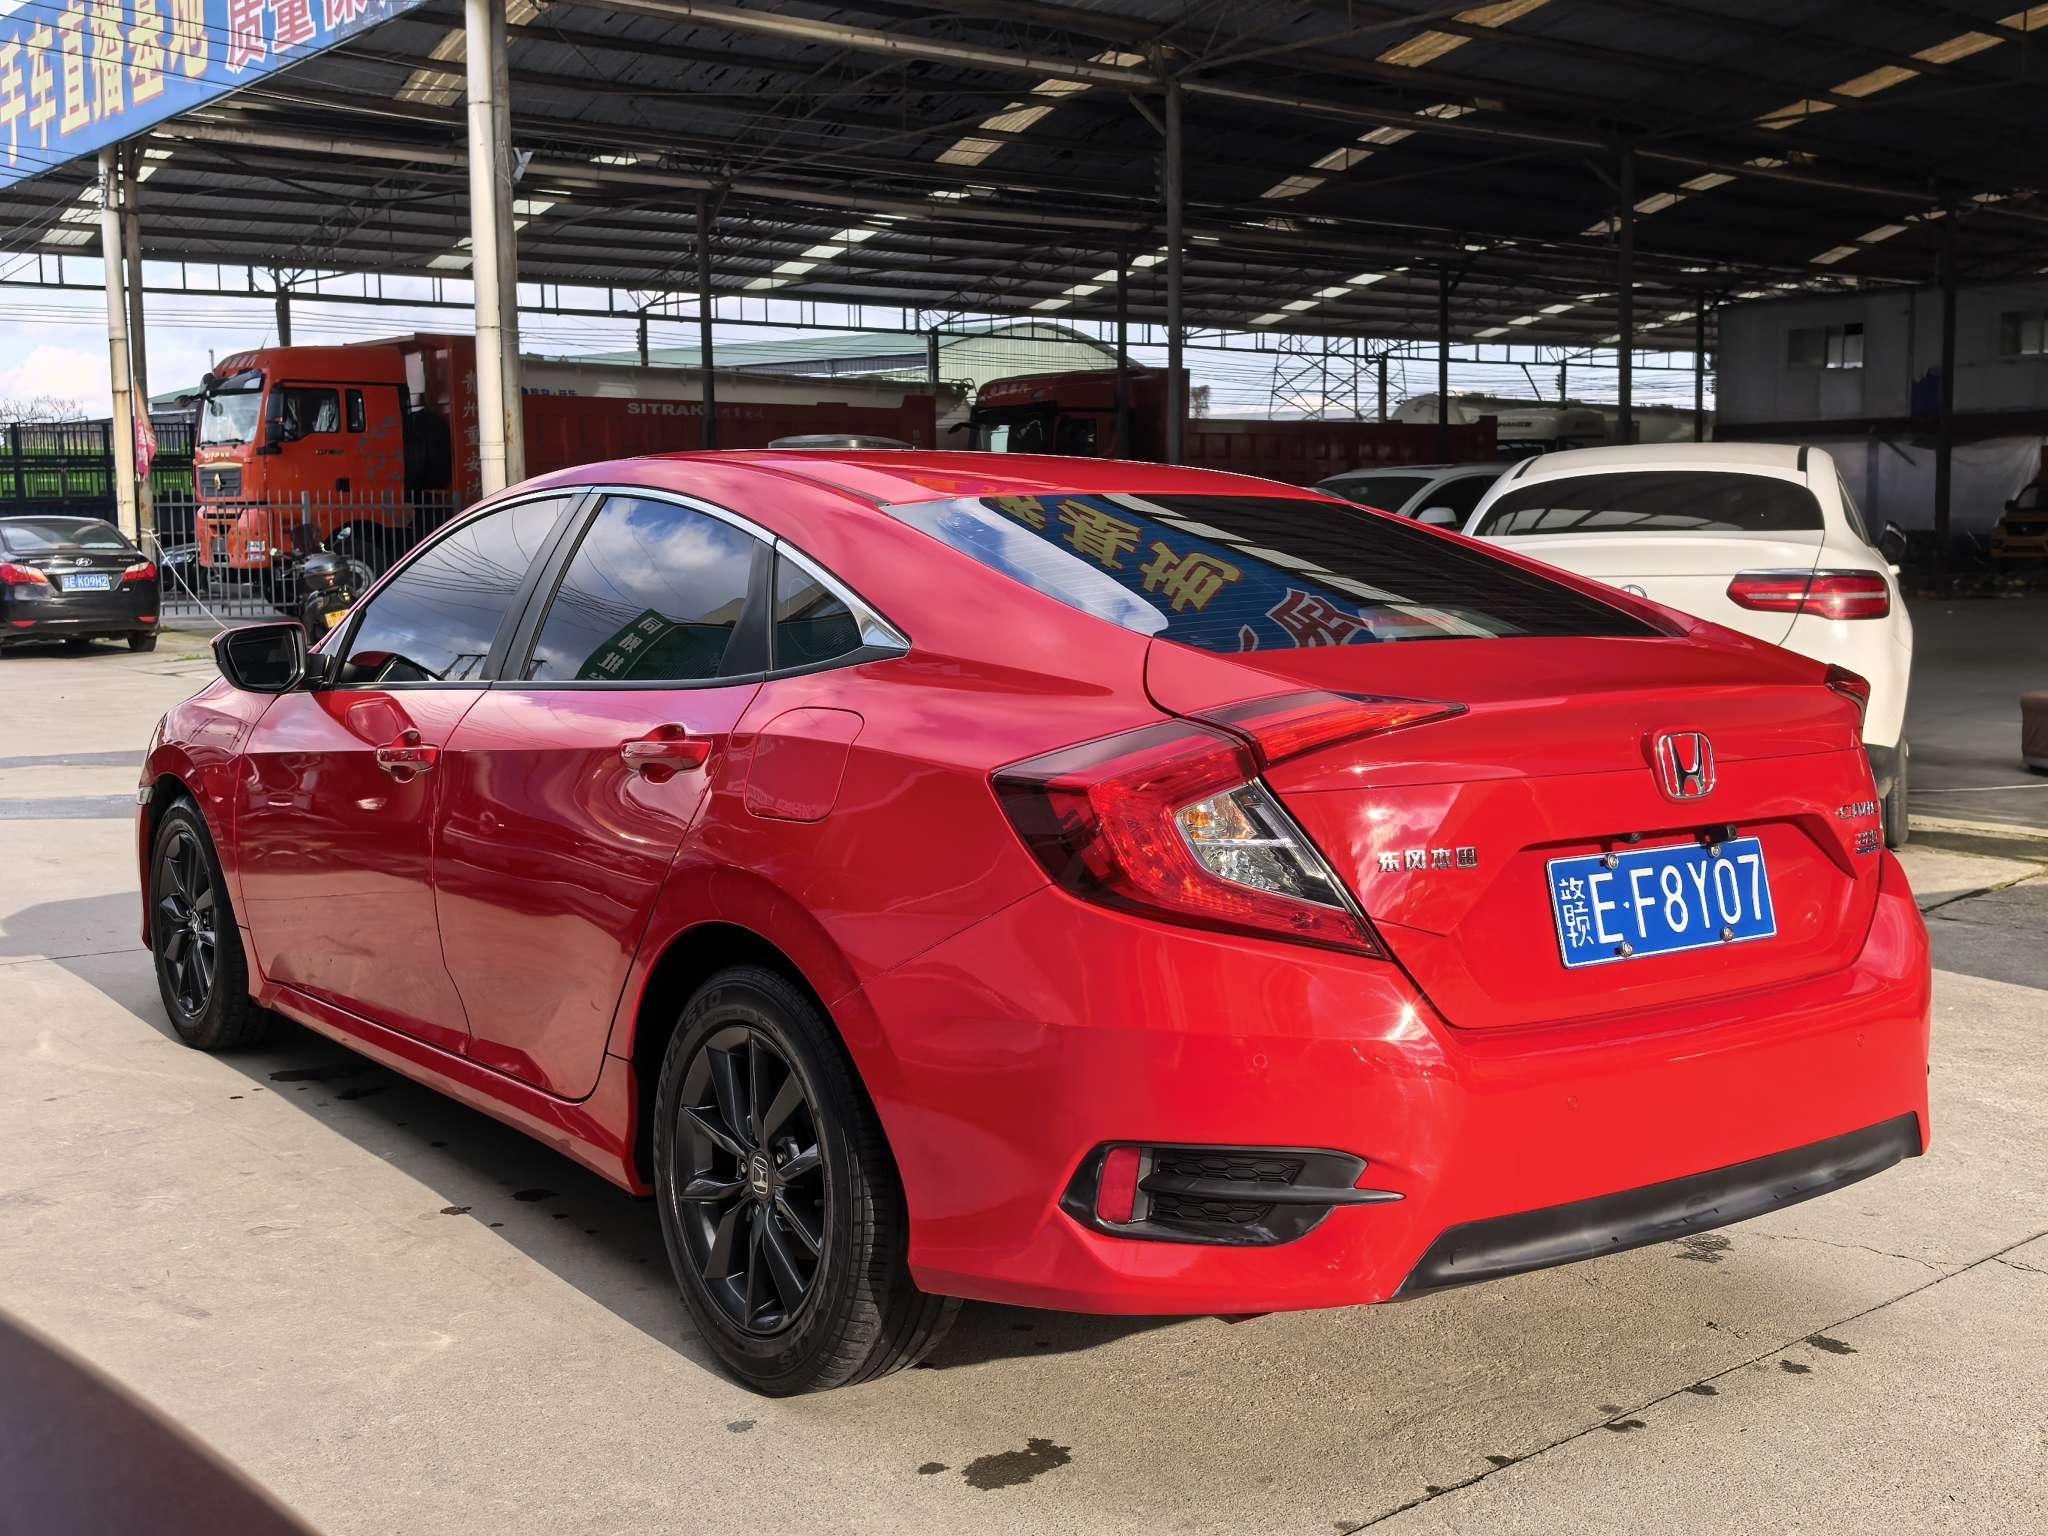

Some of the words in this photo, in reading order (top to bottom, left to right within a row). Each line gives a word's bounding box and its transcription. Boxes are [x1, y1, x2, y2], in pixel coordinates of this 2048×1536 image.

[627, 402, 704, 416] SITRAK
[1377, 846, 1479, 872] 东风本田
